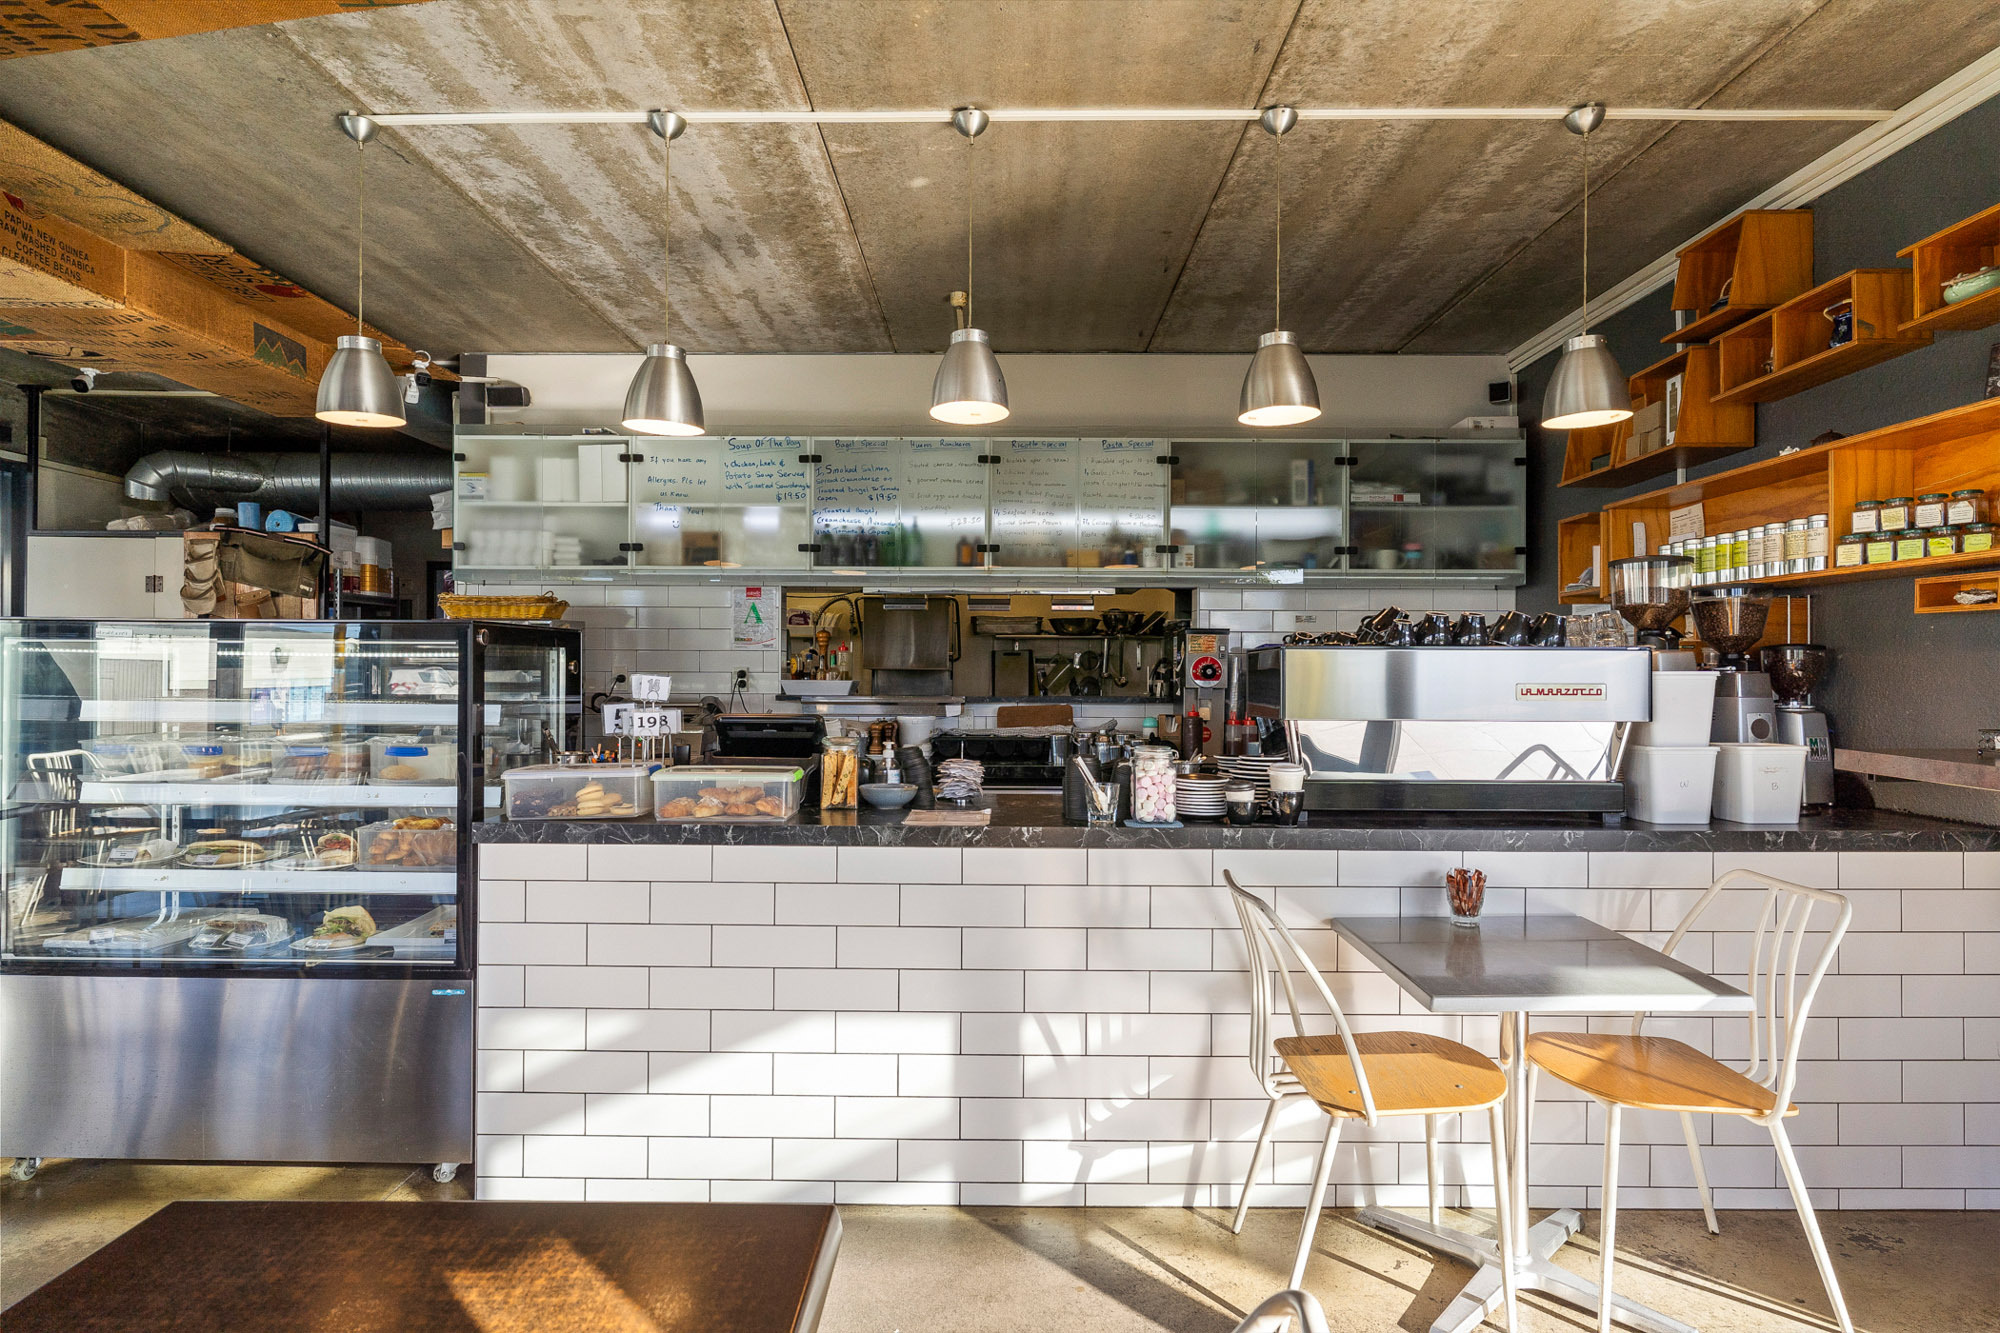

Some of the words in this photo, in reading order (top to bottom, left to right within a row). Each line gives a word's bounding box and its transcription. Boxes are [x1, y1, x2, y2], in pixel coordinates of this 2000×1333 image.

[4, 209, 34, 235] PAPUA
[36, 228, 57, 247] NEW
[58, 240, 90, 263] GUINEA
[20, 228, 57, 258] WASHED
[60, 252, 96, 276] ARABICA
[15, 239, 51, 268] COFFEE
[52, 260, 82, 281] BEANS
[727, 437, 753, 450] Soup
[768, 437, 784, 449] The
[834, 439, 856, 451] Bagel
[860, 439, 889, 449] Special
[1041, 439, 1068, 450] Special
[1101, 439, 1124, 450] Pasta
[1127, 439, 1155, 450] Special
[755, 470, 775, 479] Soup
[777, 469, 805, 479] Served
[825, 463, 858, 475] Smoked
[653, 501, 678, 512] Thank
[743, 601, 764, 624] A
[637, 716, 657, 729] 19
